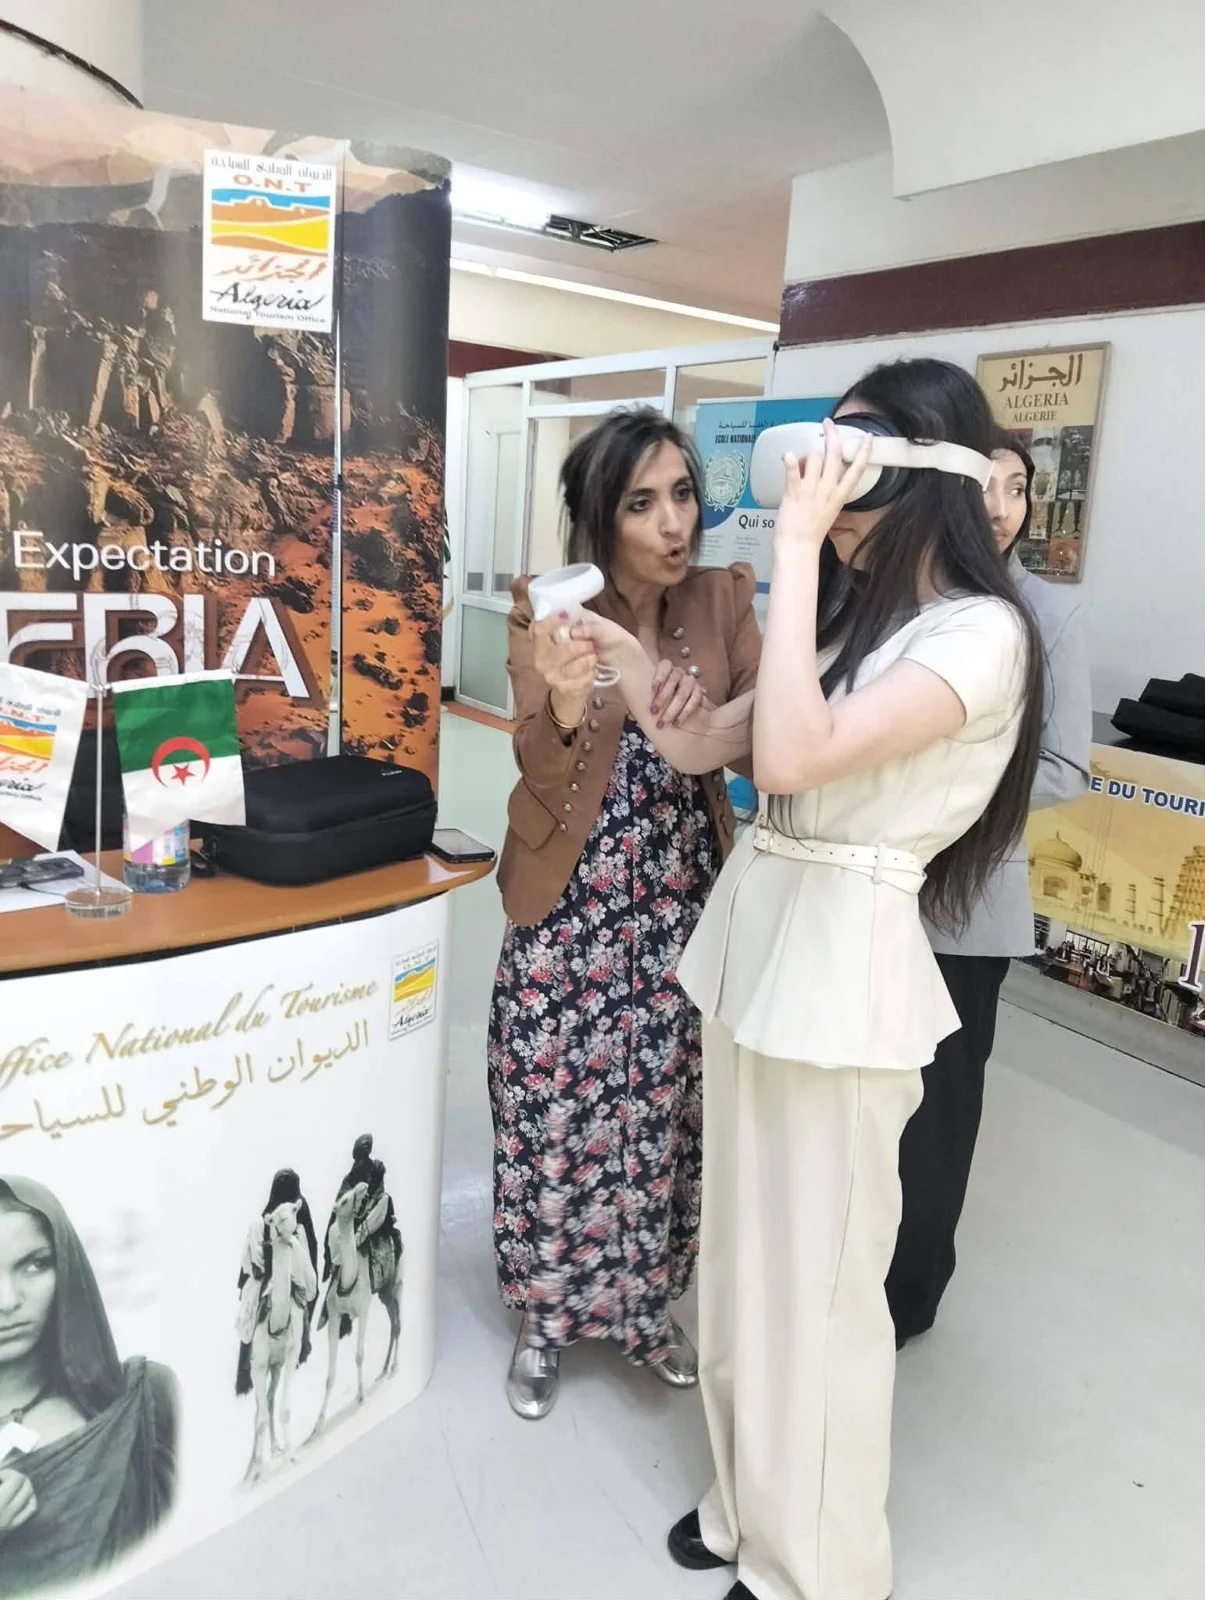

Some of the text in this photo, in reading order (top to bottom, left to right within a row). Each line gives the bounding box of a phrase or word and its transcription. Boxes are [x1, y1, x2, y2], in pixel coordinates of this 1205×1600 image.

[233, 174, 312, 193] O.N.T
[209, 282, 326, 313] Algeria
[210, 305, 252, 320] National
[297, 314, 326, 323] Office
[996, 353, 1083, 392] الجزائر
[1005, 392, 1069, 409] ALGERIA
[1013, 410, 1058, 423] ALGERIE
[738, 514, 760, 529] Qui
[12, 530, 276, 581] Expectation
[1108, 780, 1136, 799] DU
[85, 991, 243, 1063] National
[235, 984, 275, 1033] du
[280, 981, 378, 1019] Tourisme
[267, 1018, 369, 1083] الديوان
[142, 1052, 253, 1126] الوطني
